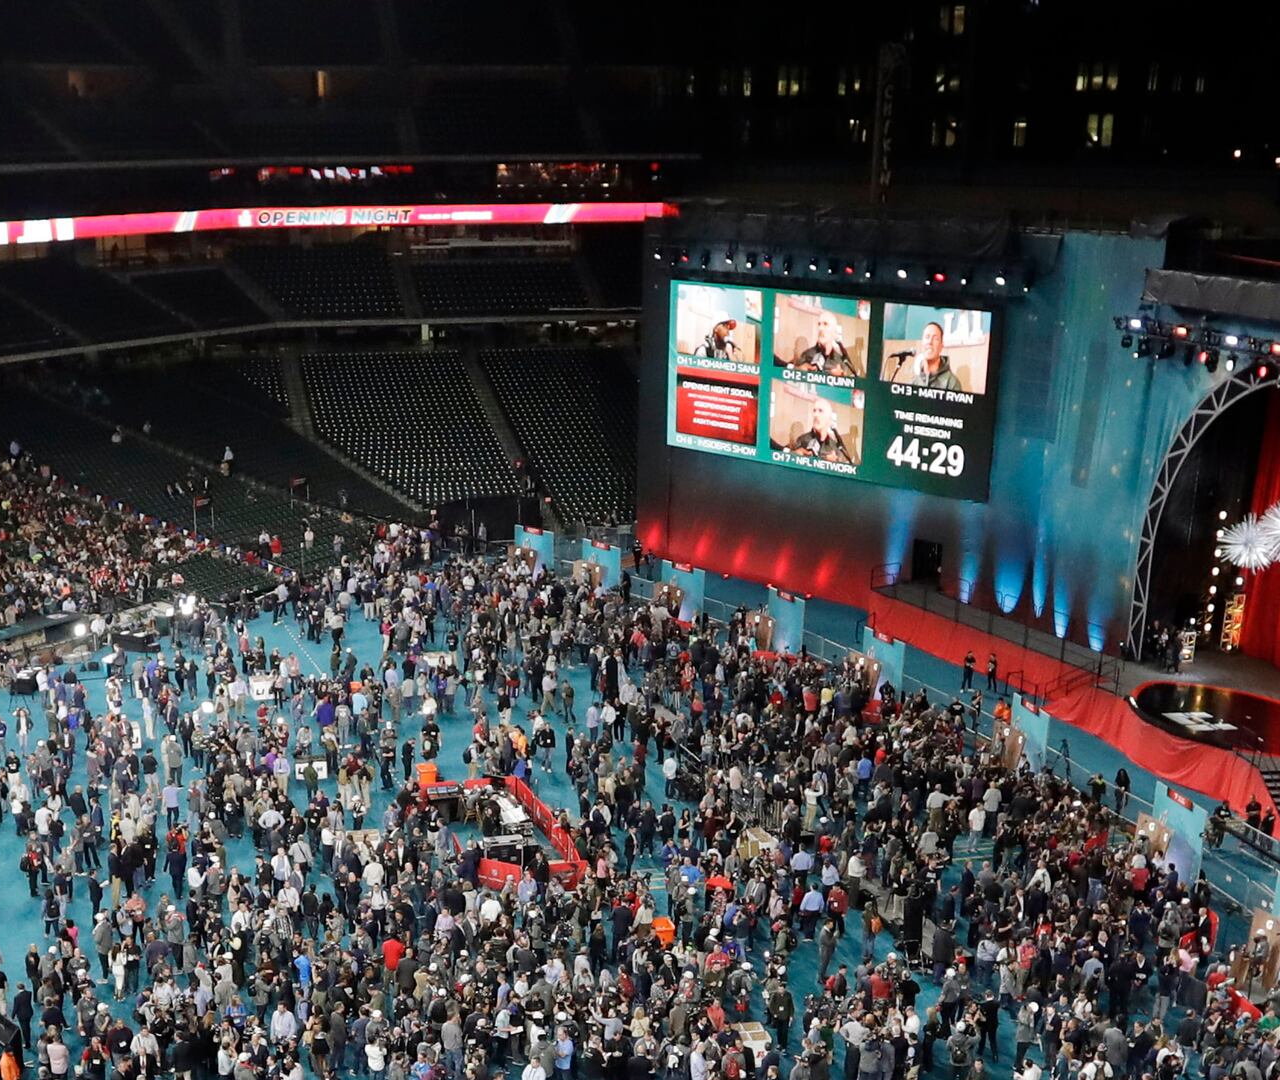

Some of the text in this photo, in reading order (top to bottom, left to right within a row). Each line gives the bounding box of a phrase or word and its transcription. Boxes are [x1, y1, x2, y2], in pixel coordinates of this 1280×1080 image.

[257, 209, 347, 226] OPENING
[350, 208, 413, 225] NIGHT
[807, 373, 826, 384] DAN
[827, 376, 855, 388] QUINN
[891, 384, 905, 396] CH
[918, 388, 945, 400] MATT
[946, 391, 974, 404] RYAN
[894, 410, 964, 429] TIME REMAINING
[914, 425, 951, 439] SESSION
[796, 456, 814, 468] NFL
[815, 460, 857, 475] NETWORK
[886, 435, 965, 477] 44:29
